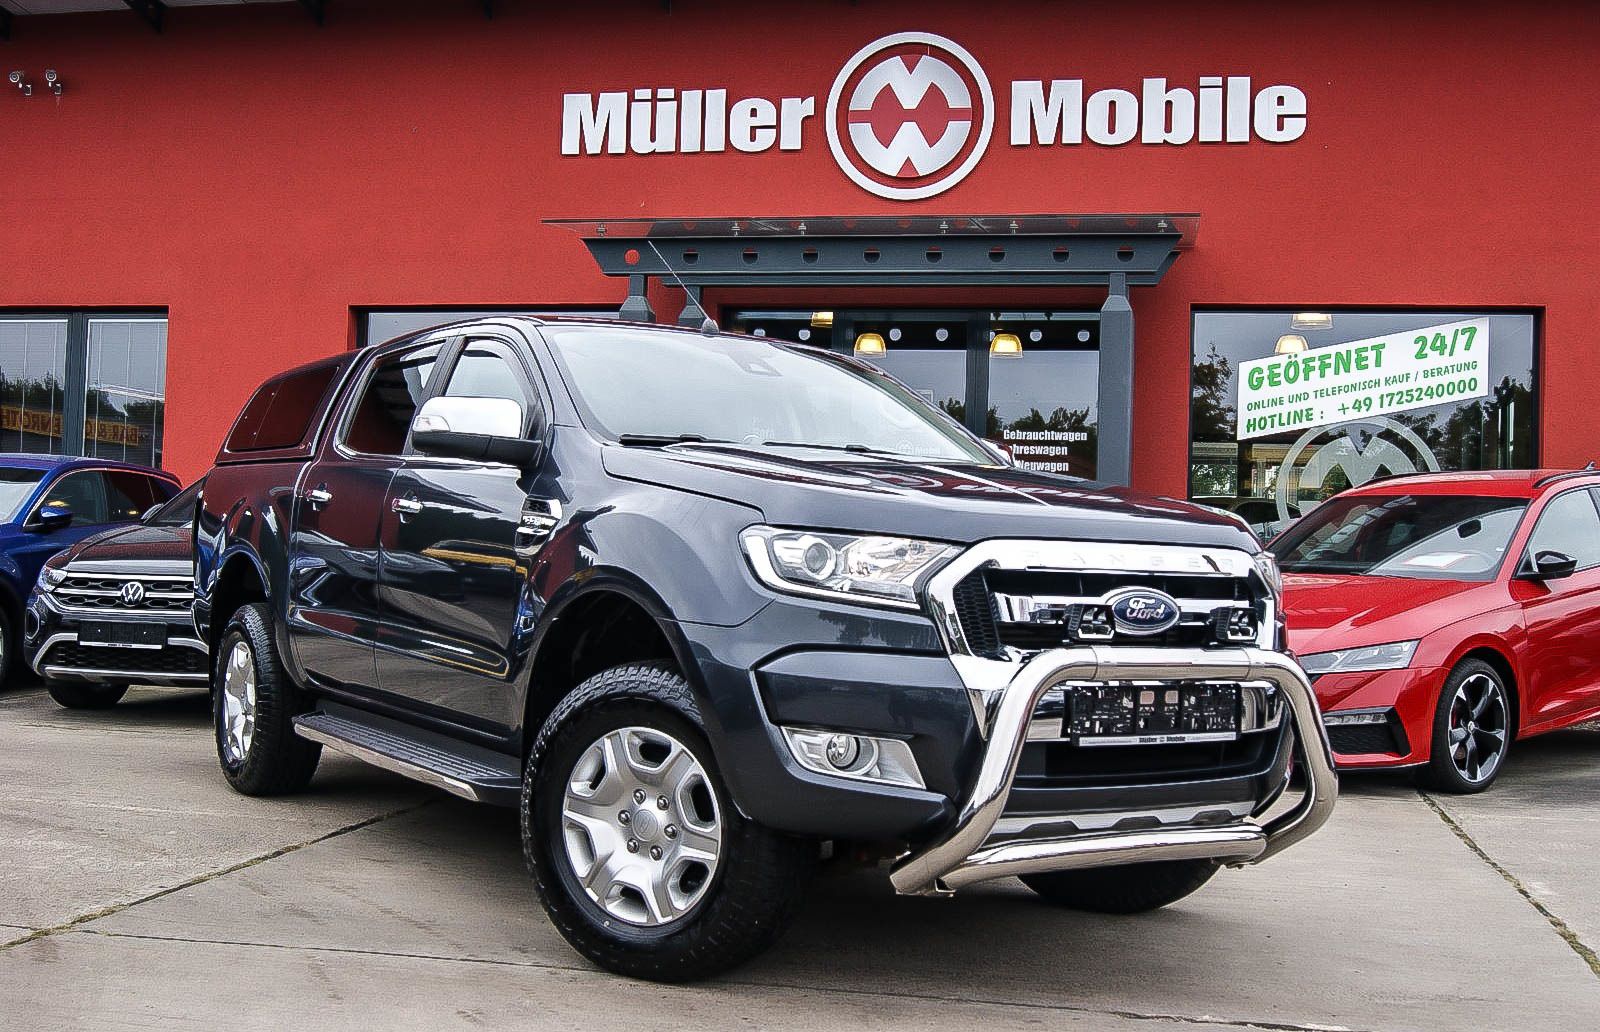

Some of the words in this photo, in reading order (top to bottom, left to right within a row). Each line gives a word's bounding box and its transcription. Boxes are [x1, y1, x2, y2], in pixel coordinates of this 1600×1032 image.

[562, 88, 815, 155] Müller
[1010, 75, 1307, 146] Mobile
[1247, 343, 1386, 391] GEÖFFNET
[1413, 326, 1478, 360] 24/7
[1246, 396, 1285, 412] ONLINE
[1288, 391, 1310, 404] UND
[1313, 378, 1381, 399] TELEFONISCH
[1384, 372, 1411, 387] KAUF
[1423, 360, 1478, 379] BERATUNG
[1246, 407, 1314, 433] HOTLINE
[1337, 396, 1373, 415] +49
[1379, 377, 1478, 409] 1725240000
[1003, 429, 1088, 442] Gebrauchtwagen
[1009, 444, 1068, 456] hreswagen
[1126, 597, 1166, 619] Ford
